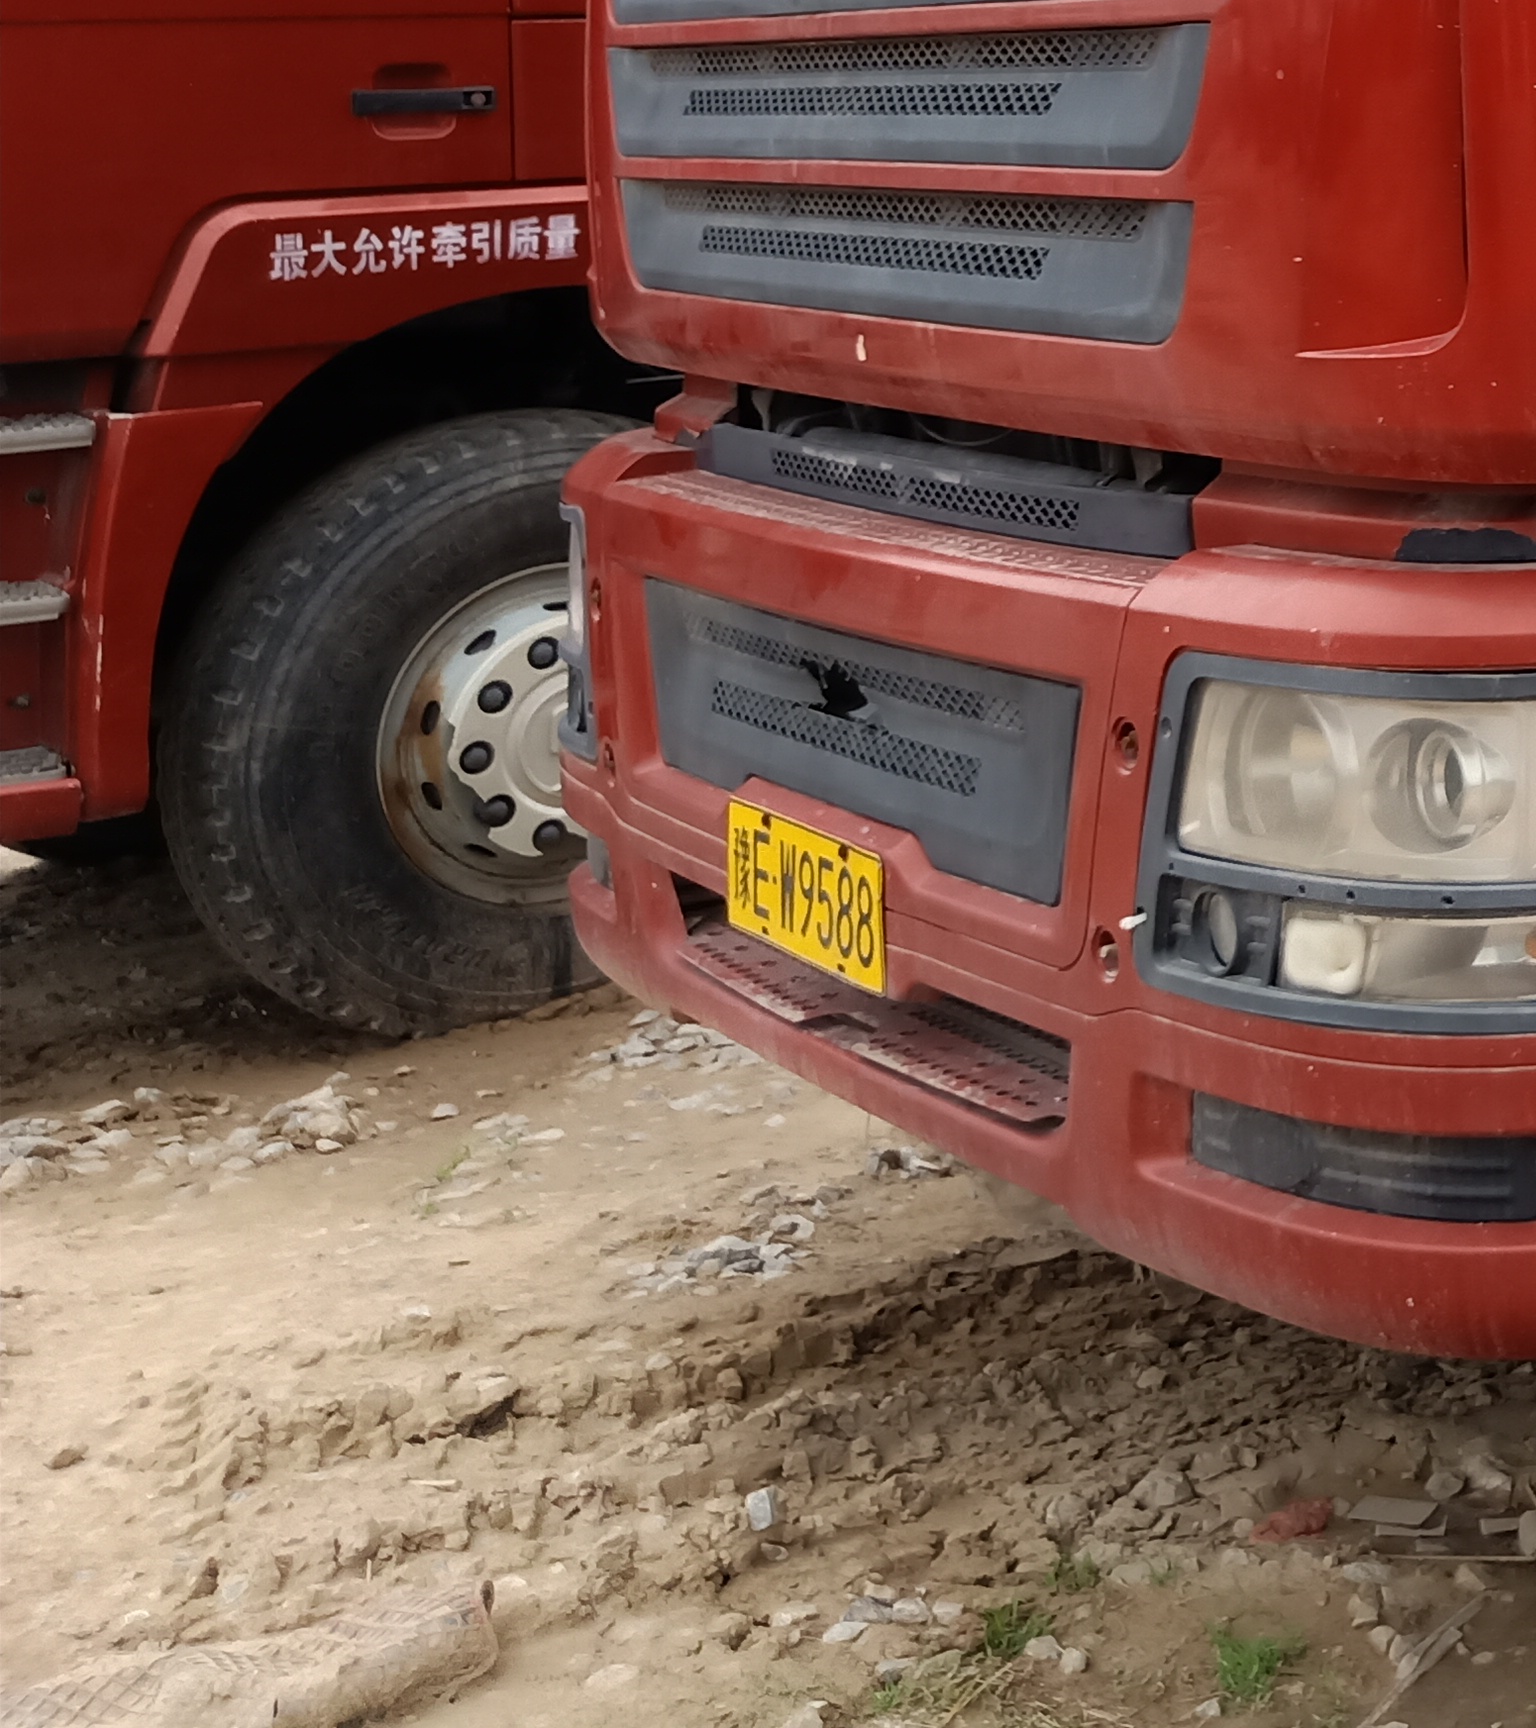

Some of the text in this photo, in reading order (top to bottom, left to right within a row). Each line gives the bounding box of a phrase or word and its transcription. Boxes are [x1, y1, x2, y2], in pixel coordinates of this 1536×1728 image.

[269, 213, 580, 281] 最大允许牵引质量
